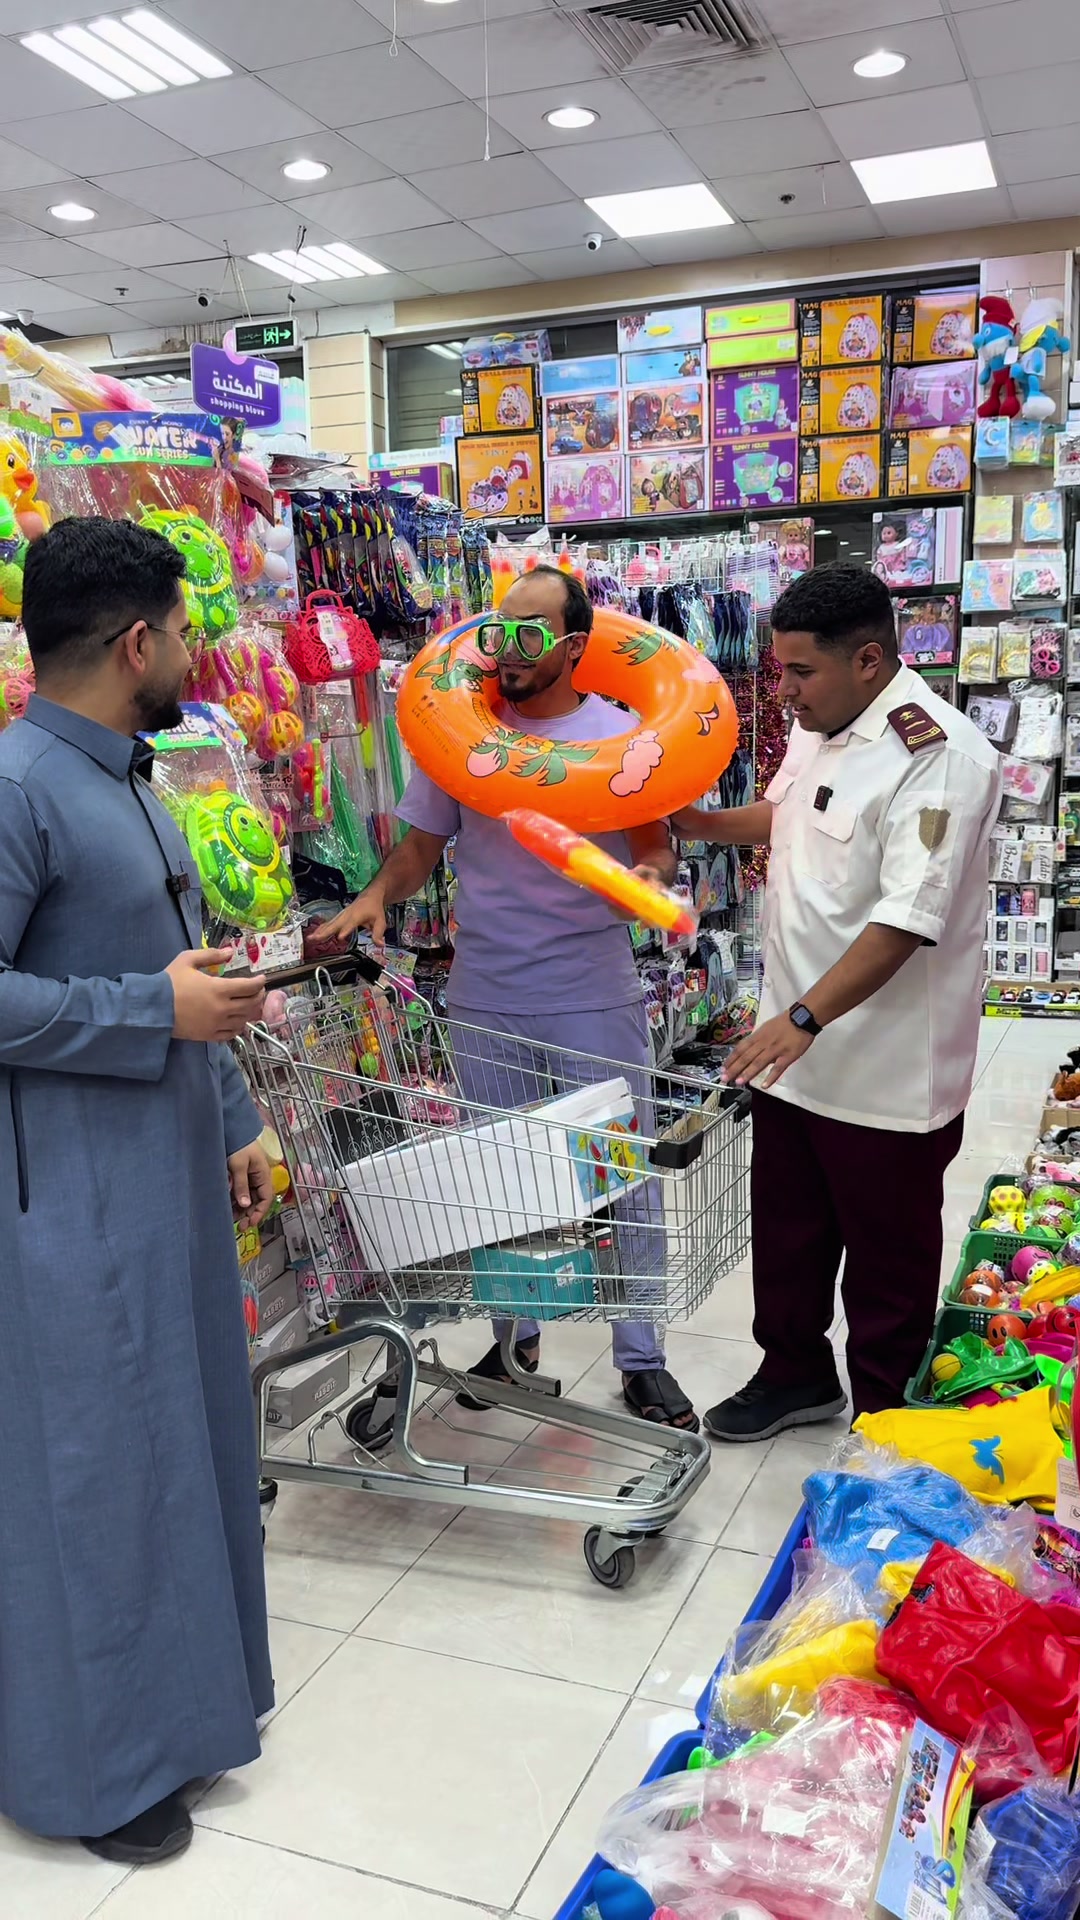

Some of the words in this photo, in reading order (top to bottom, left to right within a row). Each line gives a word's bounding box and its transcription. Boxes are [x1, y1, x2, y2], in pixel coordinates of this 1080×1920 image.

[212, 371, 262, 400] المكتبة
[210, 397, 244, 413] shopping
[126, 425, 198, 449] WATER
[132, 448, 153, 457] GUN
[157, 449, 190, 460] SERIES
[1001, 844, 1018, 879] Bride
[262, 1297, 286, 1321] RABBIT
[314, 1379, 336, 1401] RABBIT
